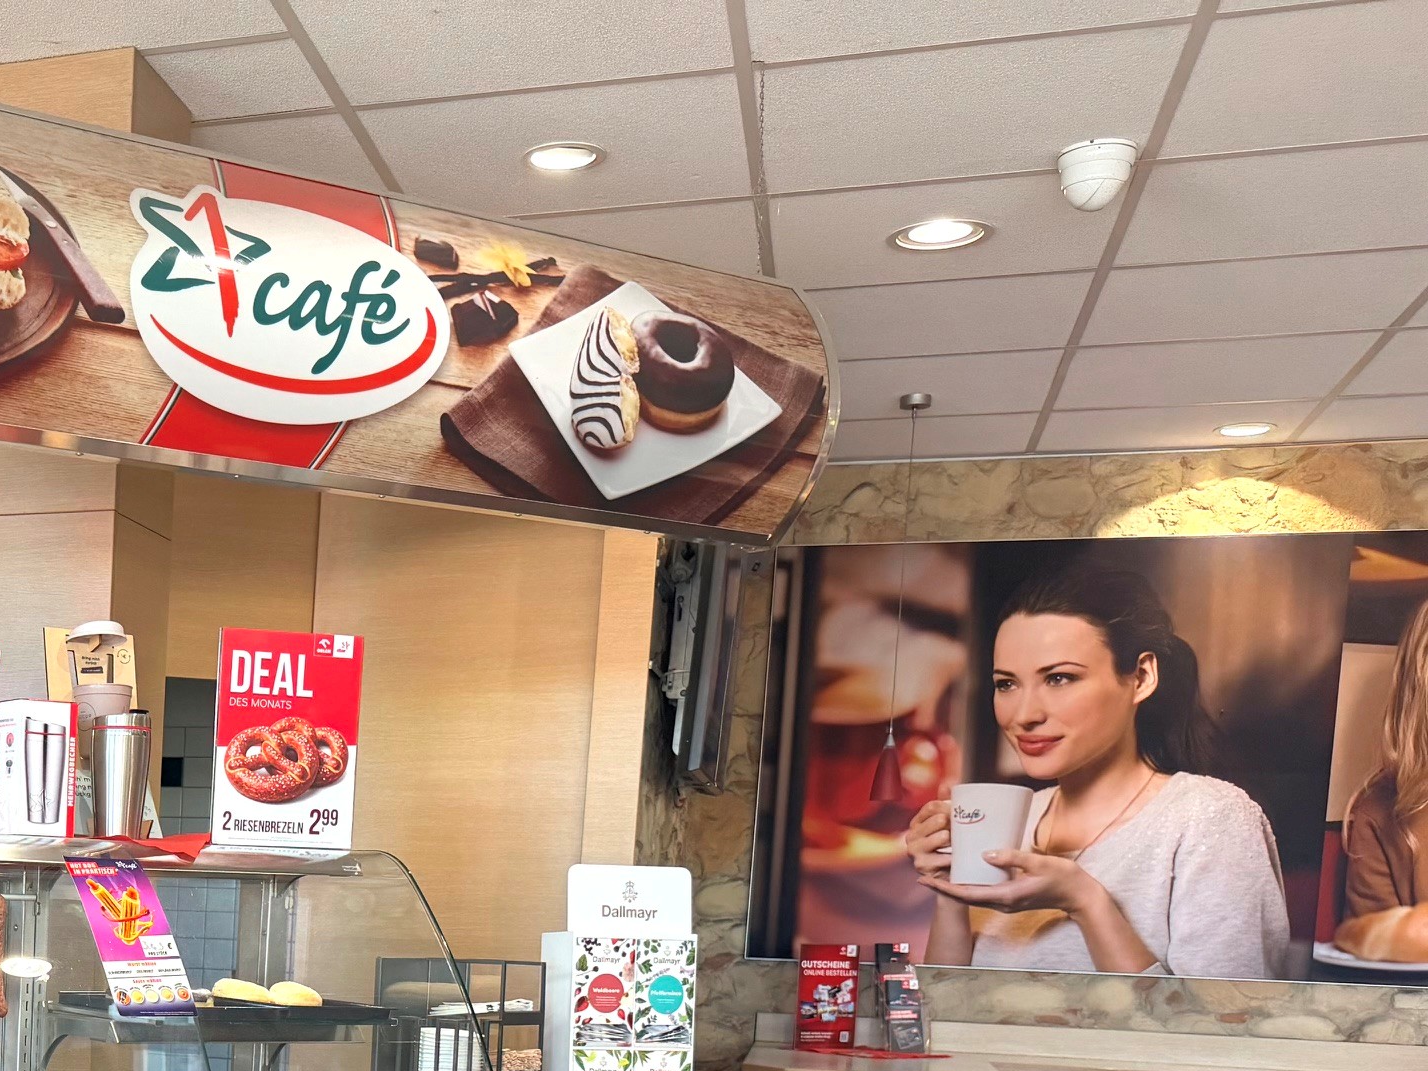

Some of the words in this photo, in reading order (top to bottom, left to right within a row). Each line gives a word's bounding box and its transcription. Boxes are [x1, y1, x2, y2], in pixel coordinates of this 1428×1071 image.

[252, 261, 410, 375] café
[230, 649, 313, 698] DEAL
[229, 697, 248, 707] DES
[251, 699, 292, 710] MONATS
[67, 736, 76, 807] MEHRWEGBECHER
[222, 811, 232, 831] 2
[234, 819, 303, 834] RIESENBREZELN
[602, 905, 658, 921] Dallmayr
[592, 956, 620, 964] Dallmayr
[801, 960, 850, 969] GUTSCHEINE
